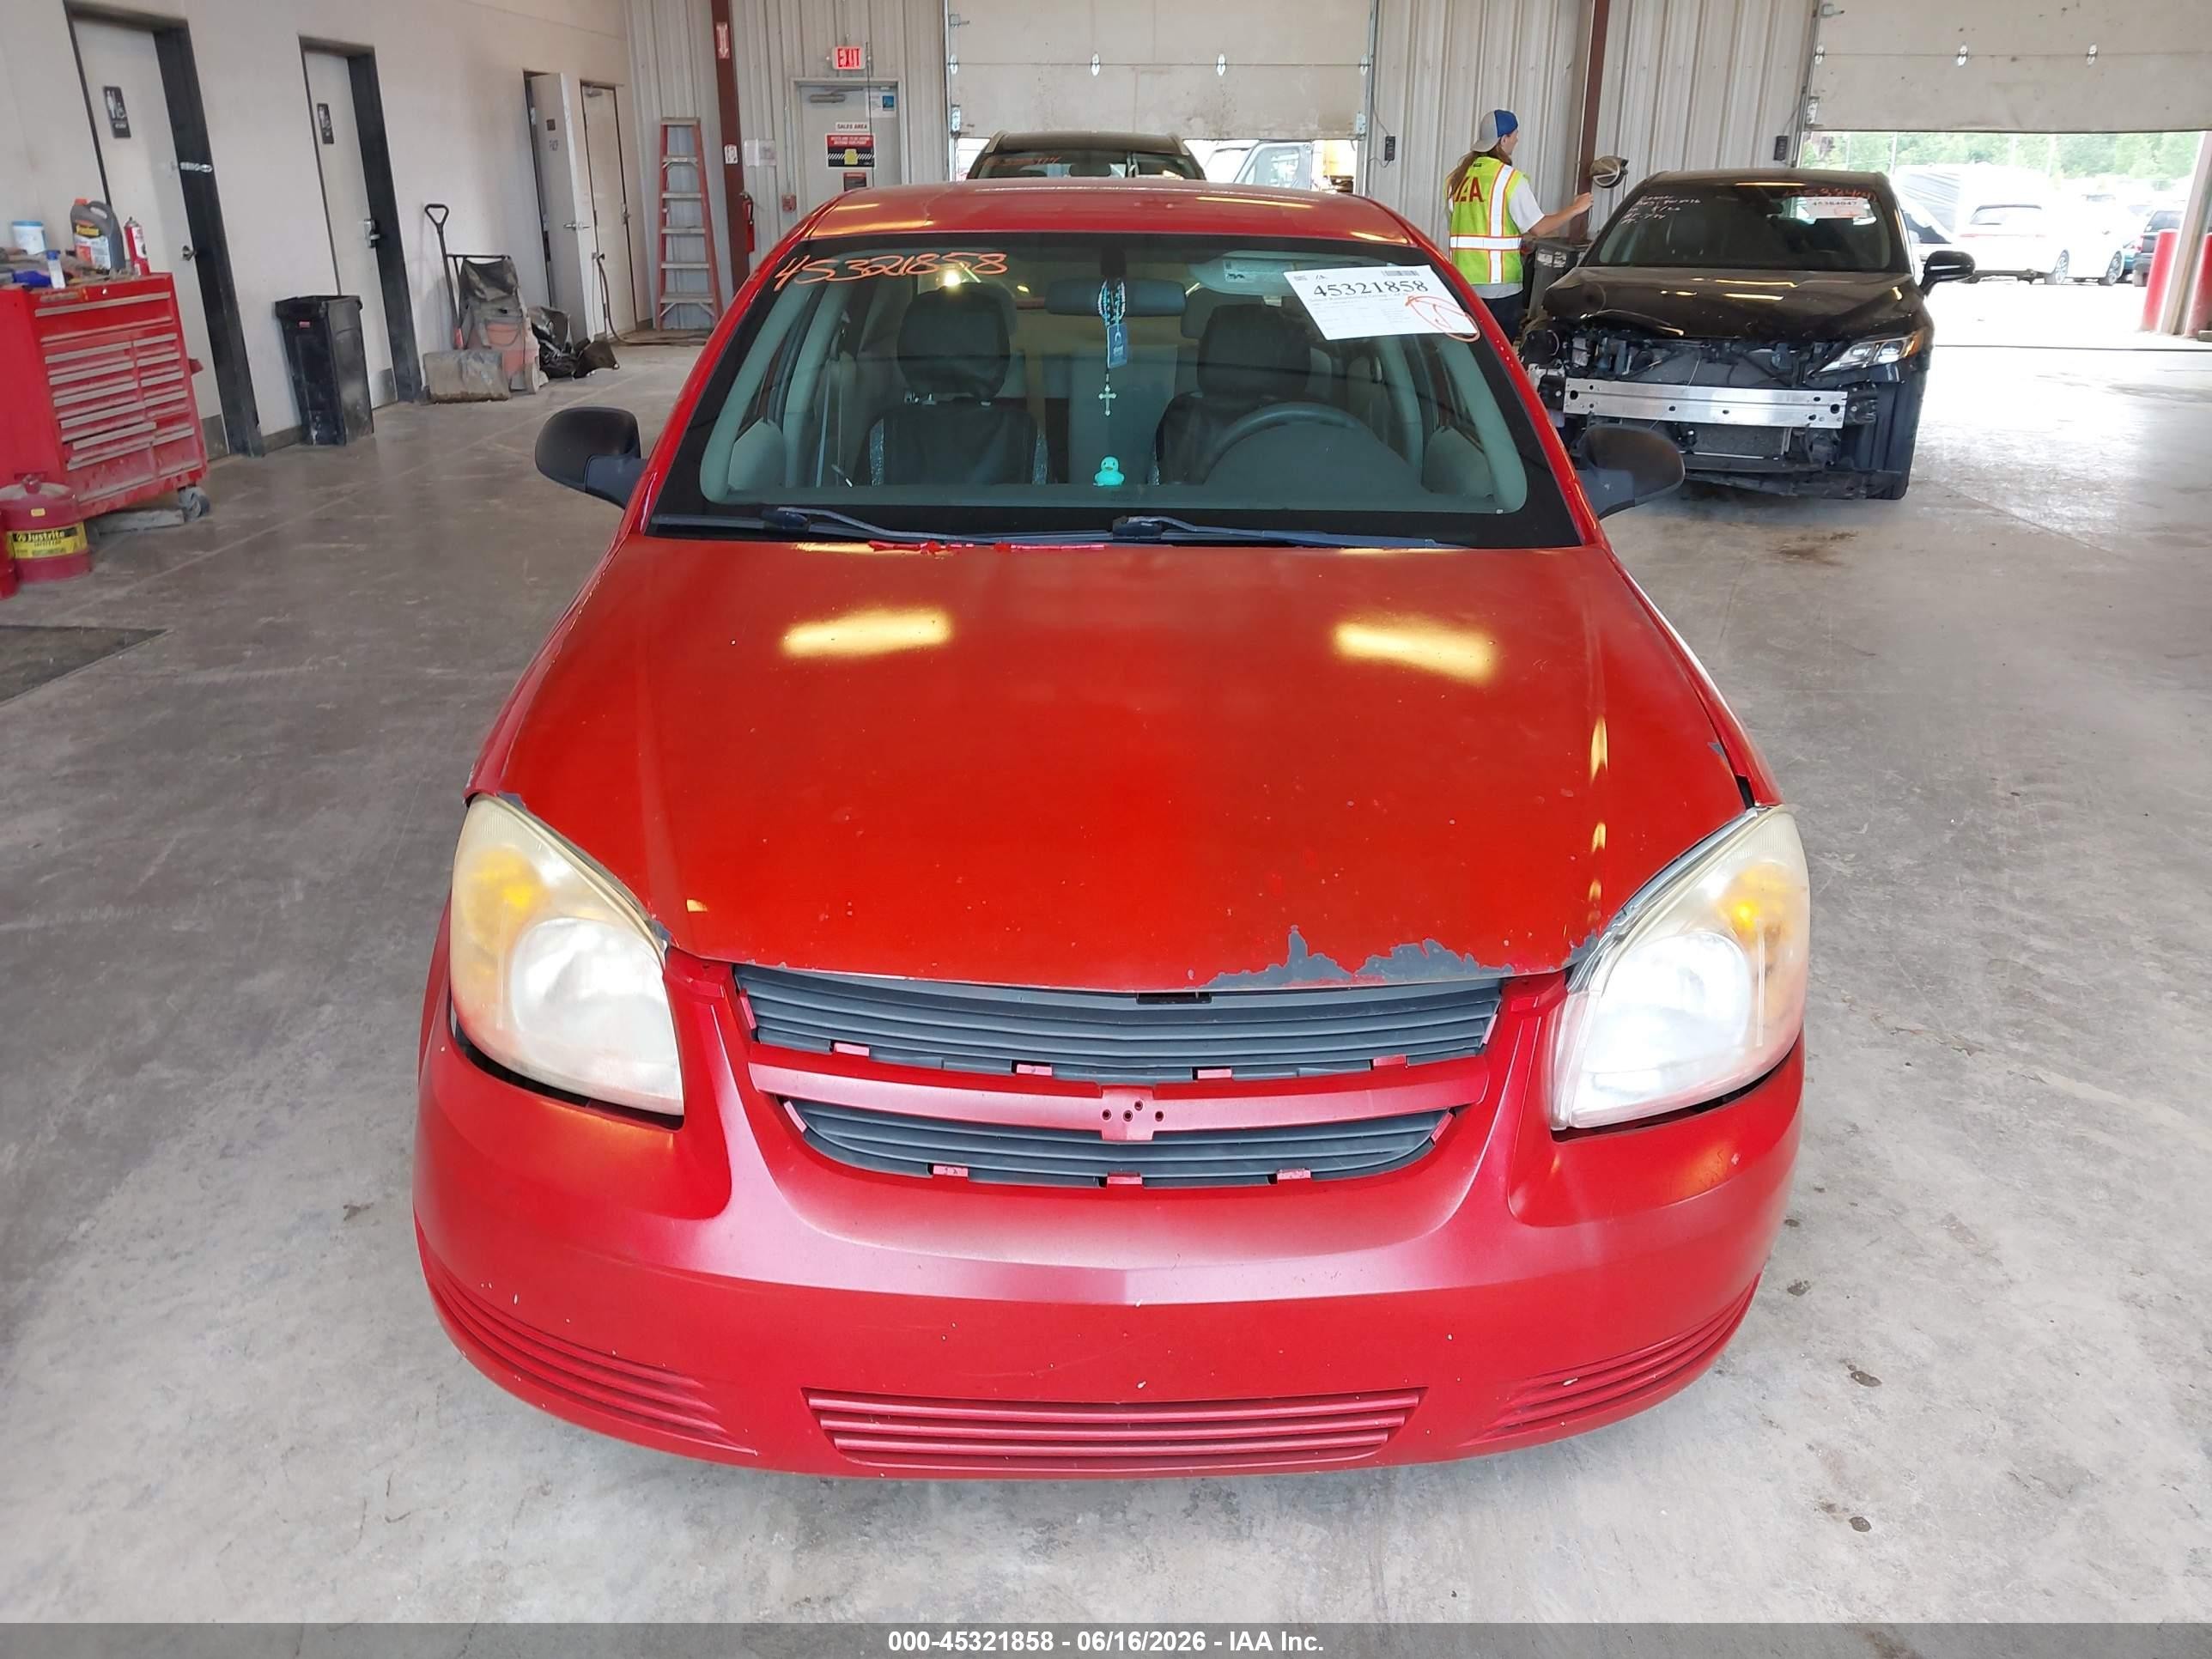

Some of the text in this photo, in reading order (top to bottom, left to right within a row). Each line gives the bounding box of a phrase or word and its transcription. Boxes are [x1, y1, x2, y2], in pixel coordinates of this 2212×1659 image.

[837, 47, 860, 68] EXIT
[774, 252, 1007, 292] 45321858
[1313, 280, 1429, 297] 45321858
